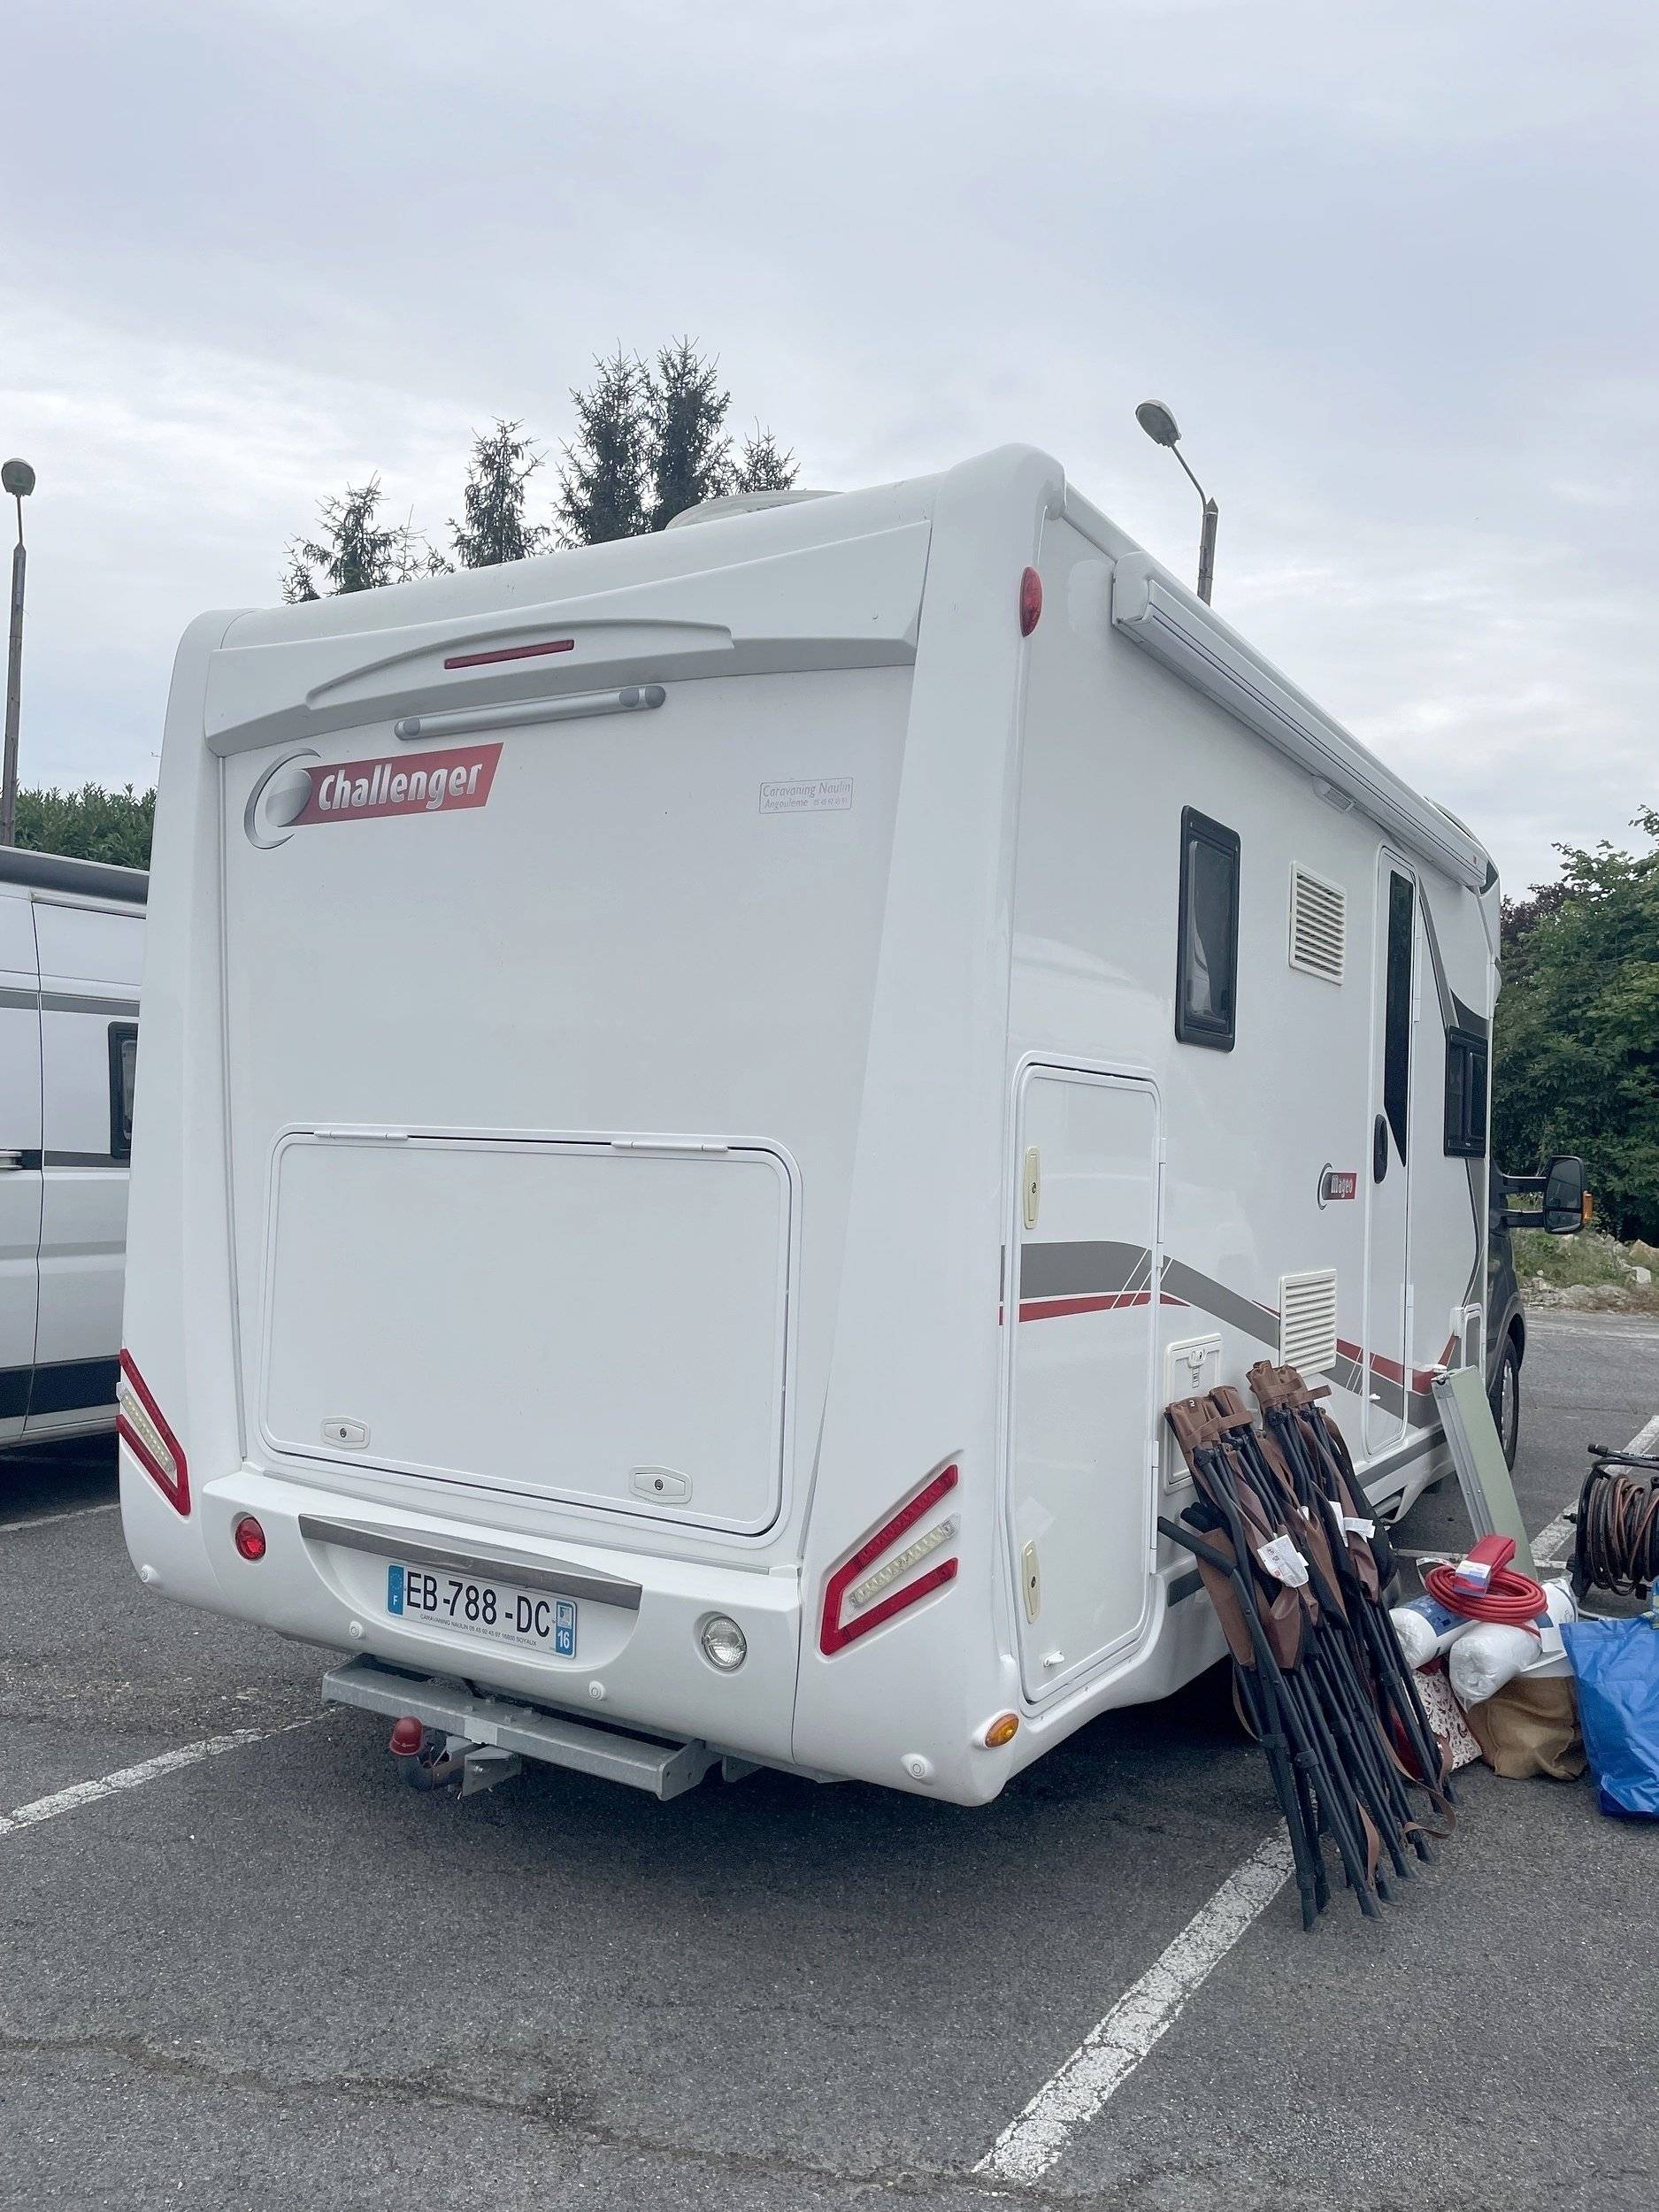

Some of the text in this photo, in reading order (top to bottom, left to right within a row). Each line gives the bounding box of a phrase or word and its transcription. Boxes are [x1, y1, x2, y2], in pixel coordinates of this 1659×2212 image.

[319, 764, 483, 810] Challenger
[763, 781, 851, 798] Caravaning Naulin
[393, 1594, 398, 1606] F
[557, 1630, 570, 1649] 16
